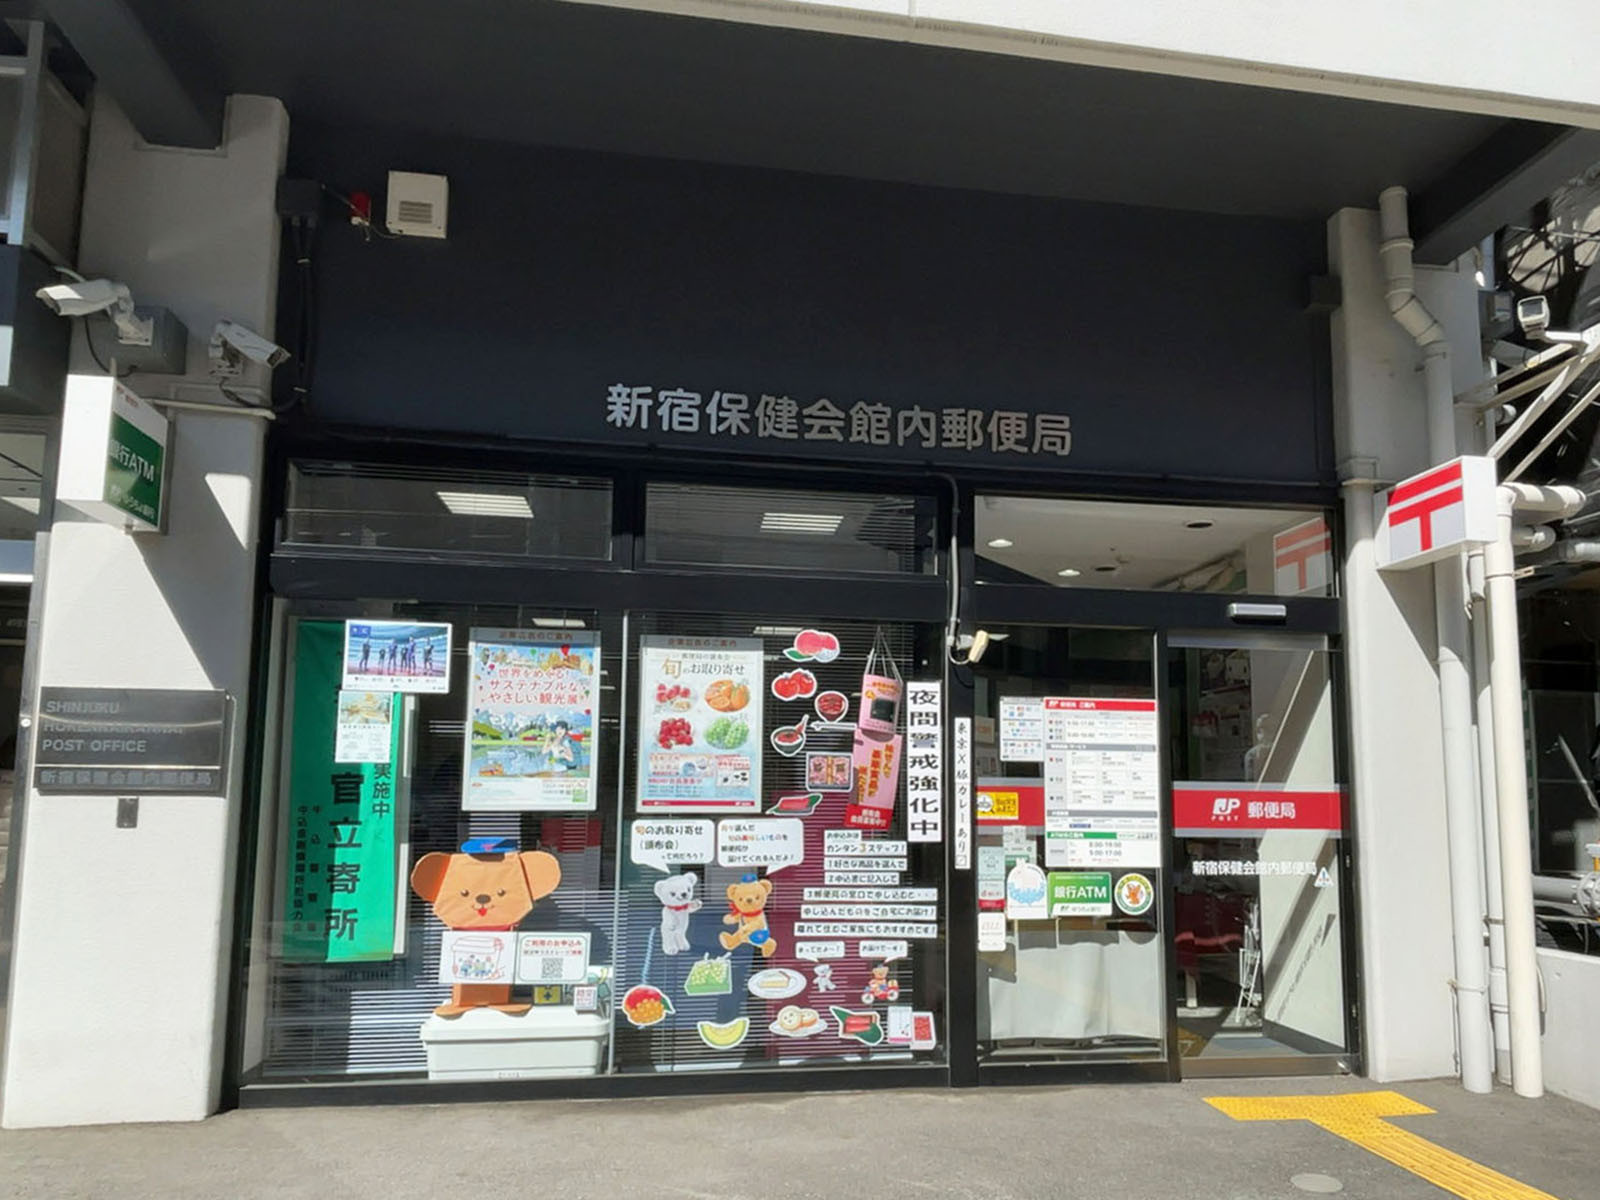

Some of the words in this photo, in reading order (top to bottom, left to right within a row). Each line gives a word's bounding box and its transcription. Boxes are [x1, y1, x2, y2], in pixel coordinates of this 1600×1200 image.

[606, 383, 1072, 457] 新宿保健会館内郵便局
[42, 739, 85, 751] POST
[90, 740, 147, 753] OFFICE
[909, 689, 939, 836] 夜間警戒強化中
[1248, 801, 1296, 819] 郵便局
[635, 825, 704, 836] 旬のお取り寄せ
[1054, 885, 1108, 899] 銀行ATM
